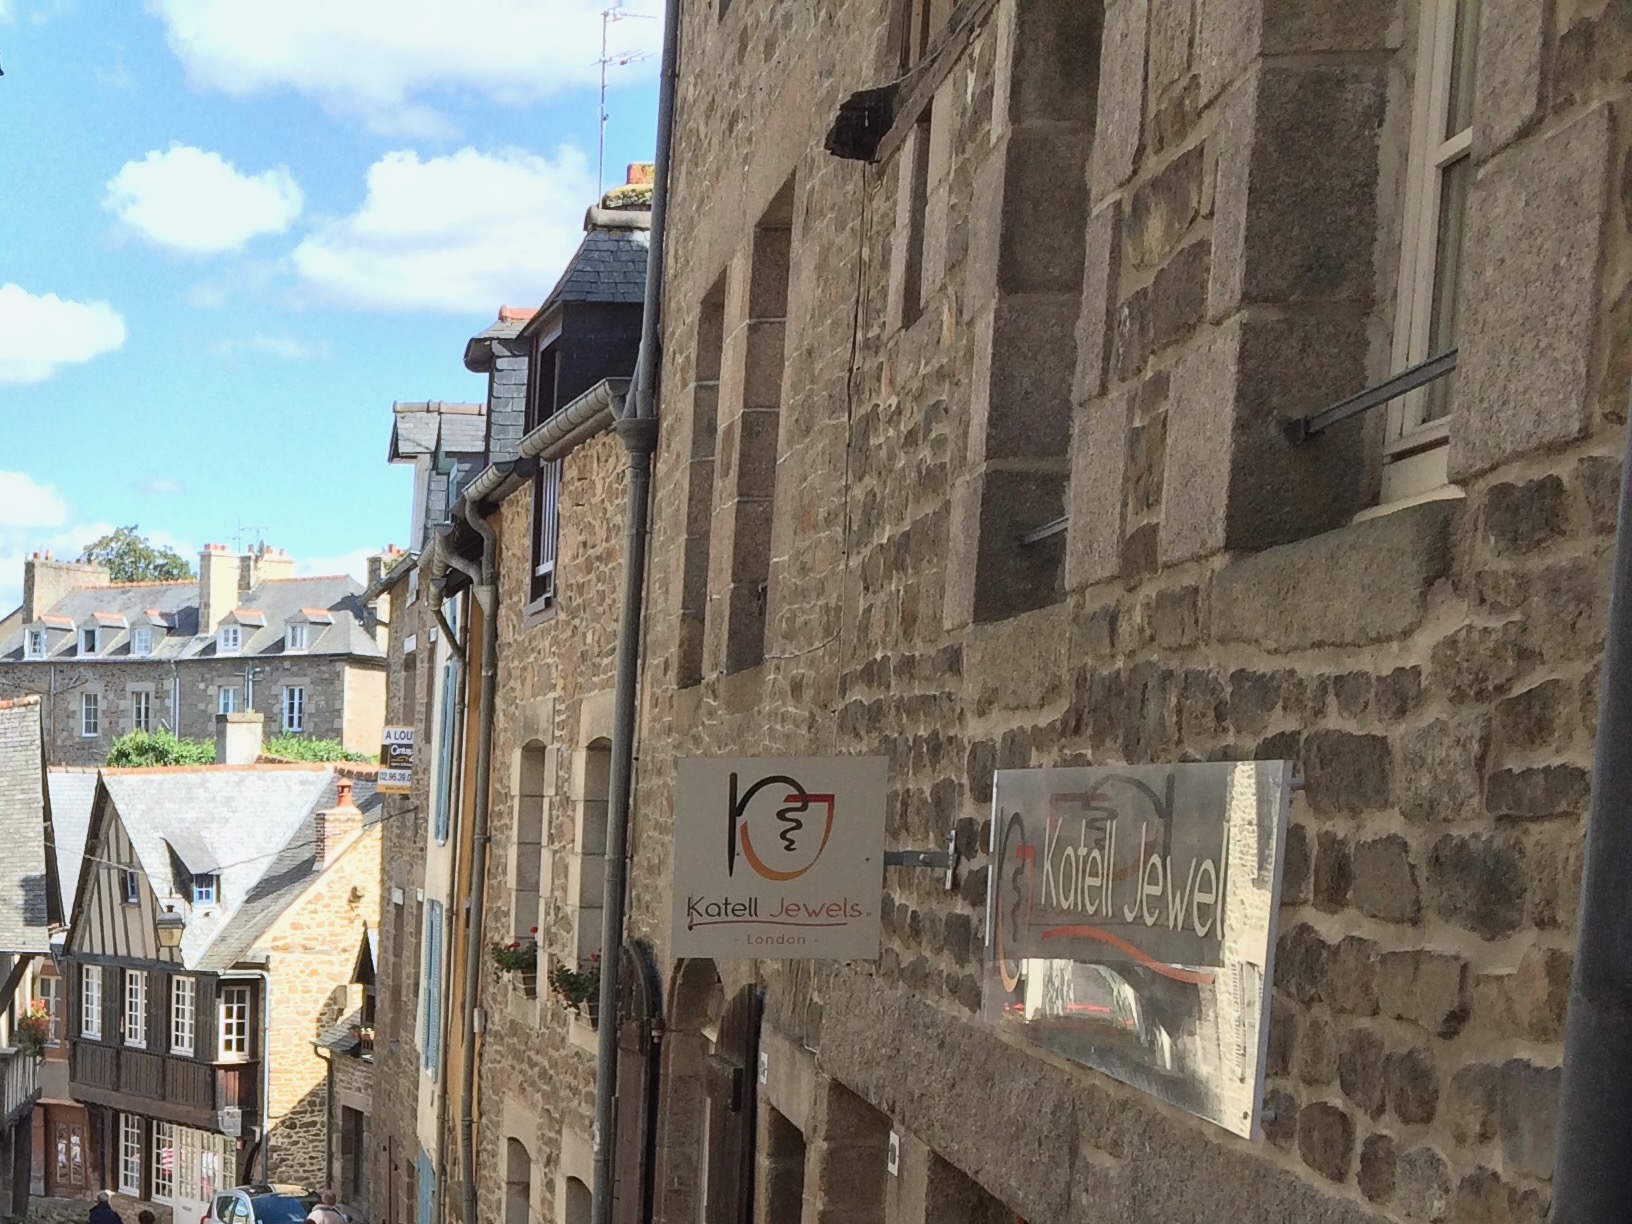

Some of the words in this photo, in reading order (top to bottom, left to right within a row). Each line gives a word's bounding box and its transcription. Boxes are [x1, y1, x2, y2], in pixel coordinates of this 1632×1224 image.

[1041, 816, 1117, 918] Katell
[686, 895, 759, 919] Katell
[768, 896, 863, 919] Jewels
[746, 933, 807, 945] London
